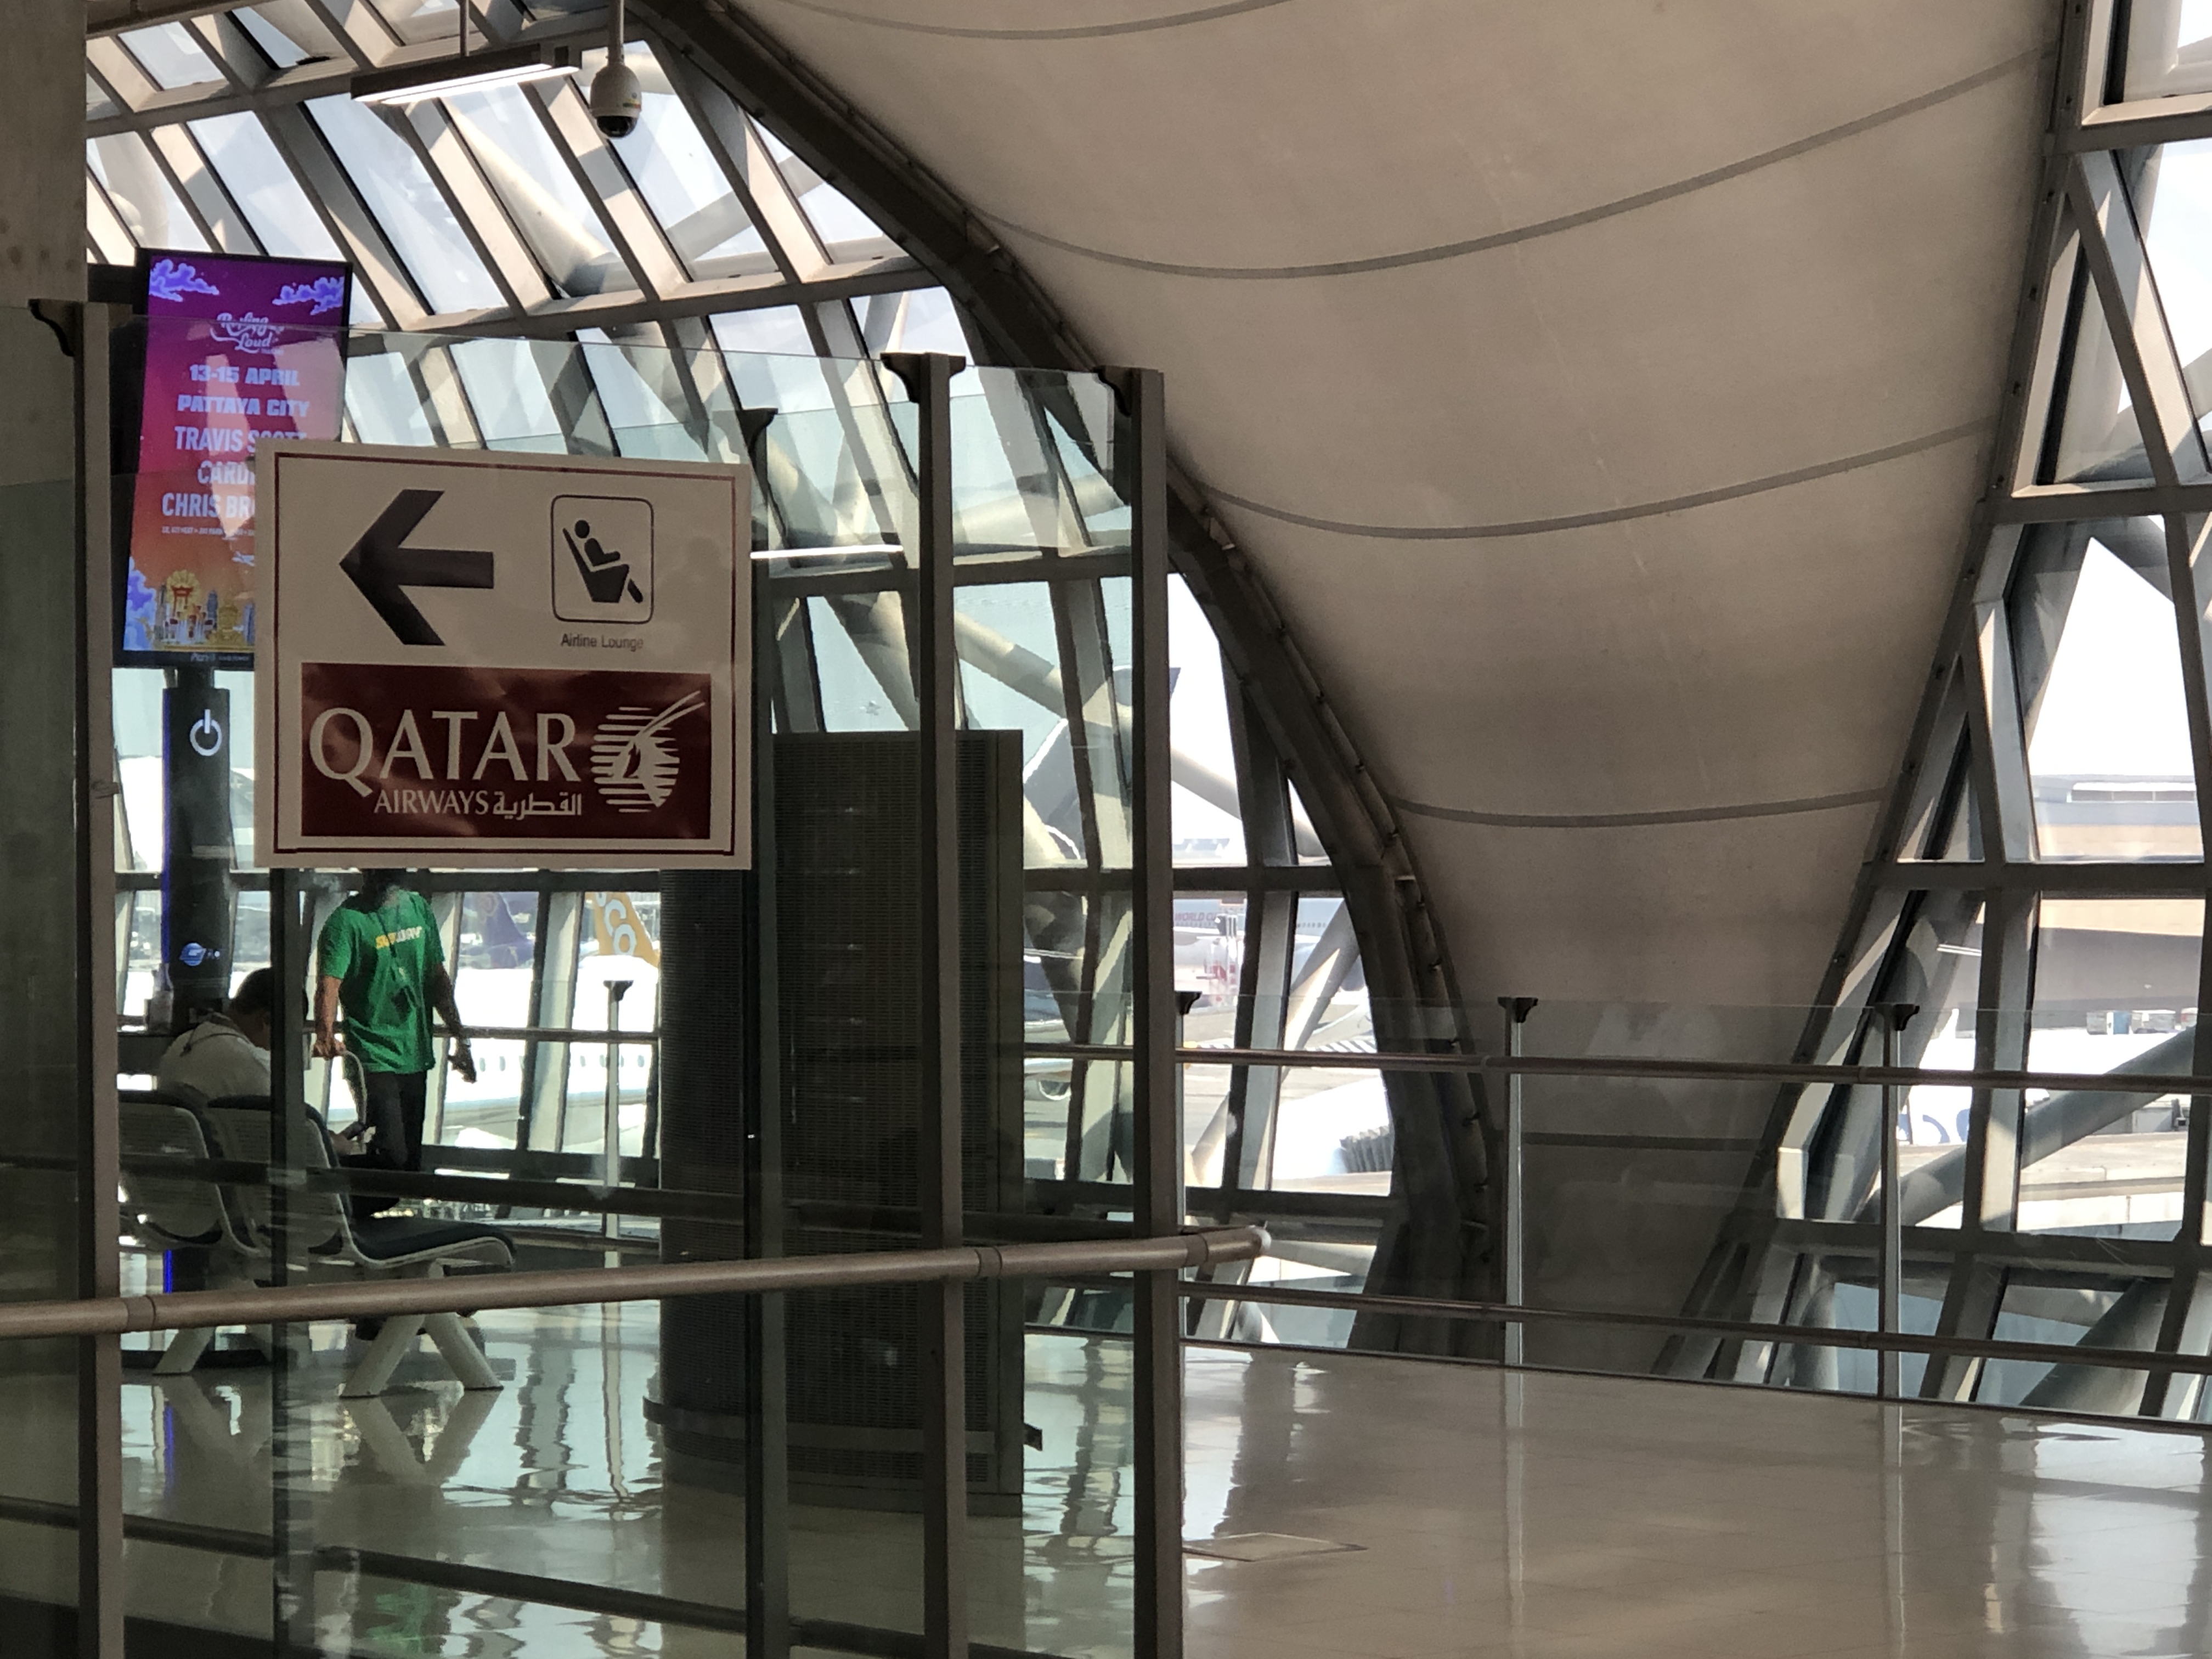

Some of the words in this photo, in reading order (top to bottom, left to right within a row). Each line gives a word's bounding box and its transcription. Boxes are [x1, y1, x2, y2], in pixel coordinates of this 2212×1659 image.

[234, 331, 273, 354] Loud
[189, 364, 240, 383] 13-15
[245, 367, 300, 386] APRIL
[177, 395, 260, 415] PATTAYA
[267, 399, 311, 417] CITY
[174, 426, 243, 452] TRAVIS
[162, 492, 221, 517] CHRIS
[225, 495, 256, 518] BR
[561, 633, 597, 647] Airline
[601, 634, 644, 652] Lounge
[309, 707, 582, 798] QATAR
[374, 789, 489, 815] AIRWAYS
[493, 791, 583, 821] القطرية
